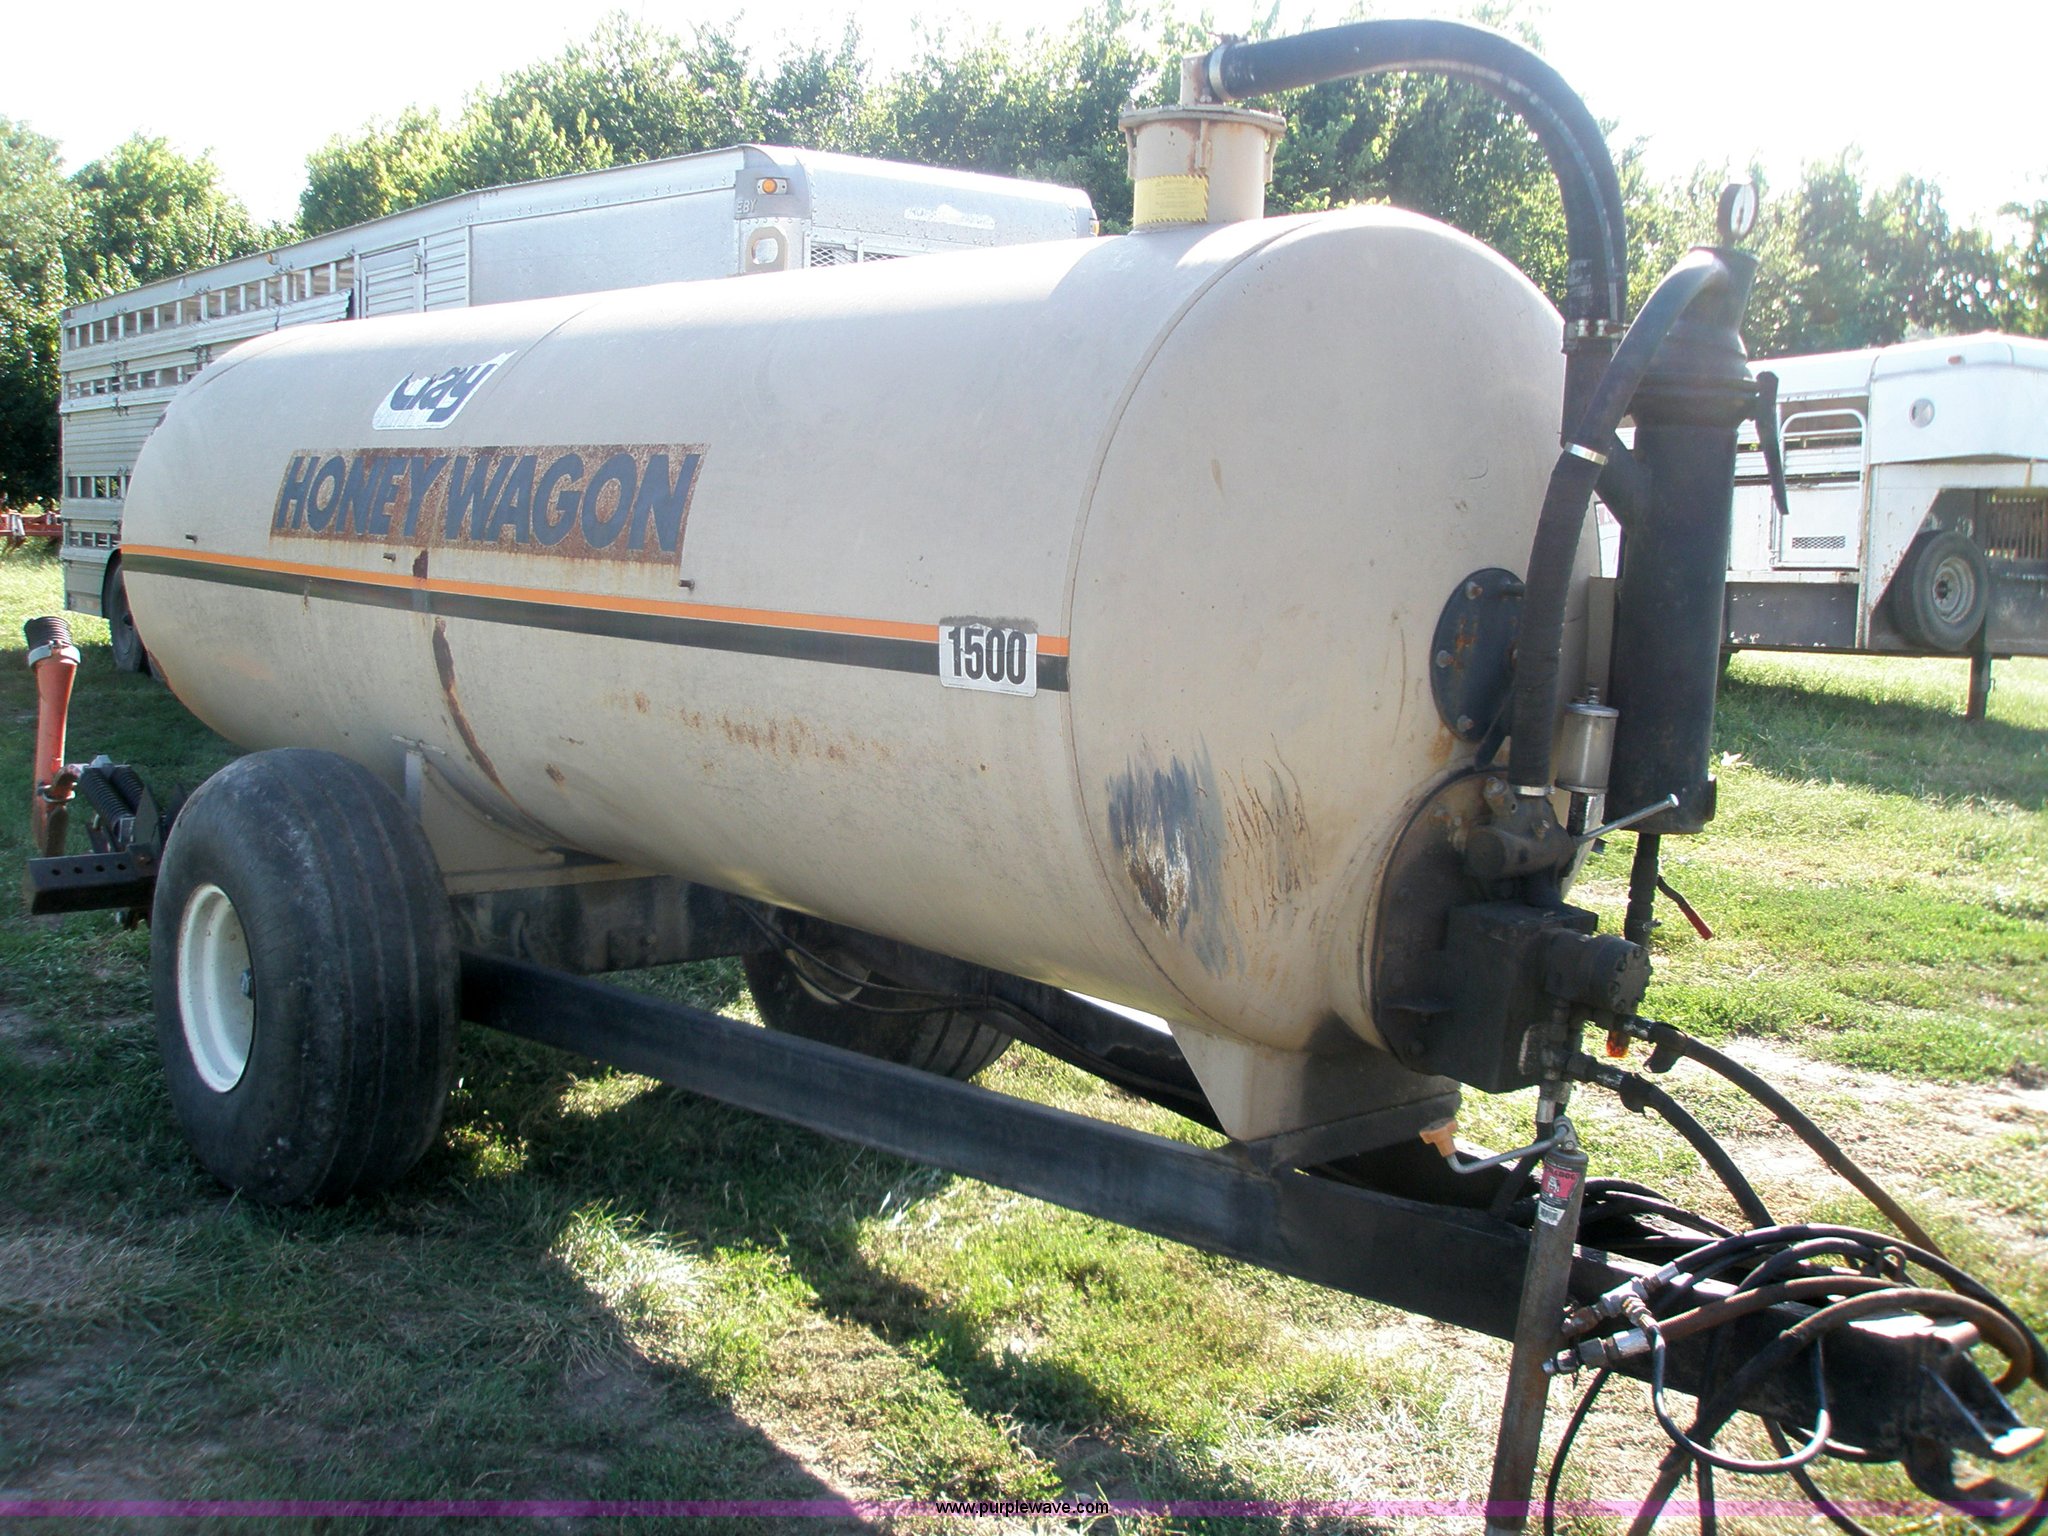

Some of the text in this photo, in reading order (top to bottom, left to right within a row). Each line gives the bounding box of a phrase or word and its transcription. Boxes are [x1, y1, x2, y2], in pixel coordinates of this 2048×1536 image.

[736, 198, 757, 214] EBY
[276, 453, 701, 552] HONEY WAGON
[948, 626, 1027, 685] 1500
